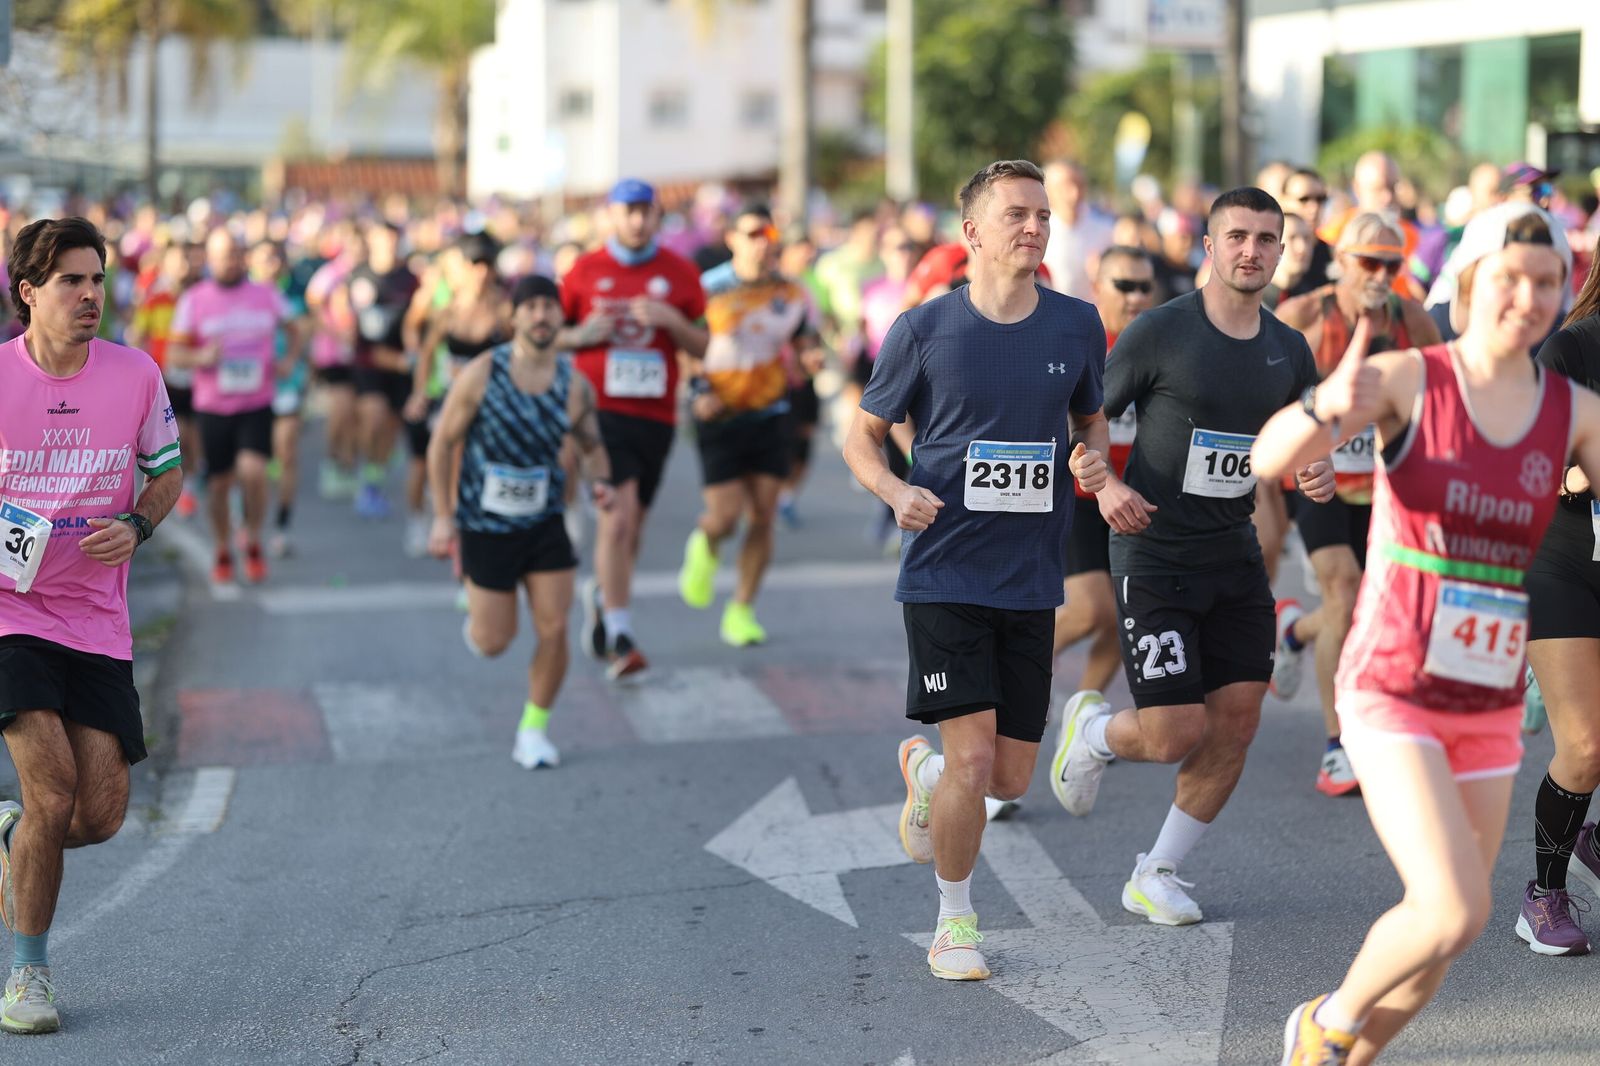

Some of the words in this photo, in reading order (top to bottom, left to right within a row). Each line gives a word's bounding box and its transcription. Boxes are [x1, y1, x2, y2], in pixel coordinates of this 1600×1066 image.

[41, 428, 91, 447] XXXVI
[0, 449, 45, 473] EDIA
[47, 444, 131, 473] MARATÓN
[92, 474, 122, 492] 2026
[971, 462, 1050, 490] 2318
[79, 496, 113, 506] MARATHON
[1444, 479, 1534, 526] Ripon
[1453, 615, 1522, 657] 415
[1137, 630, 1187, 680] 23
[923, 672, 947, 693] MU
